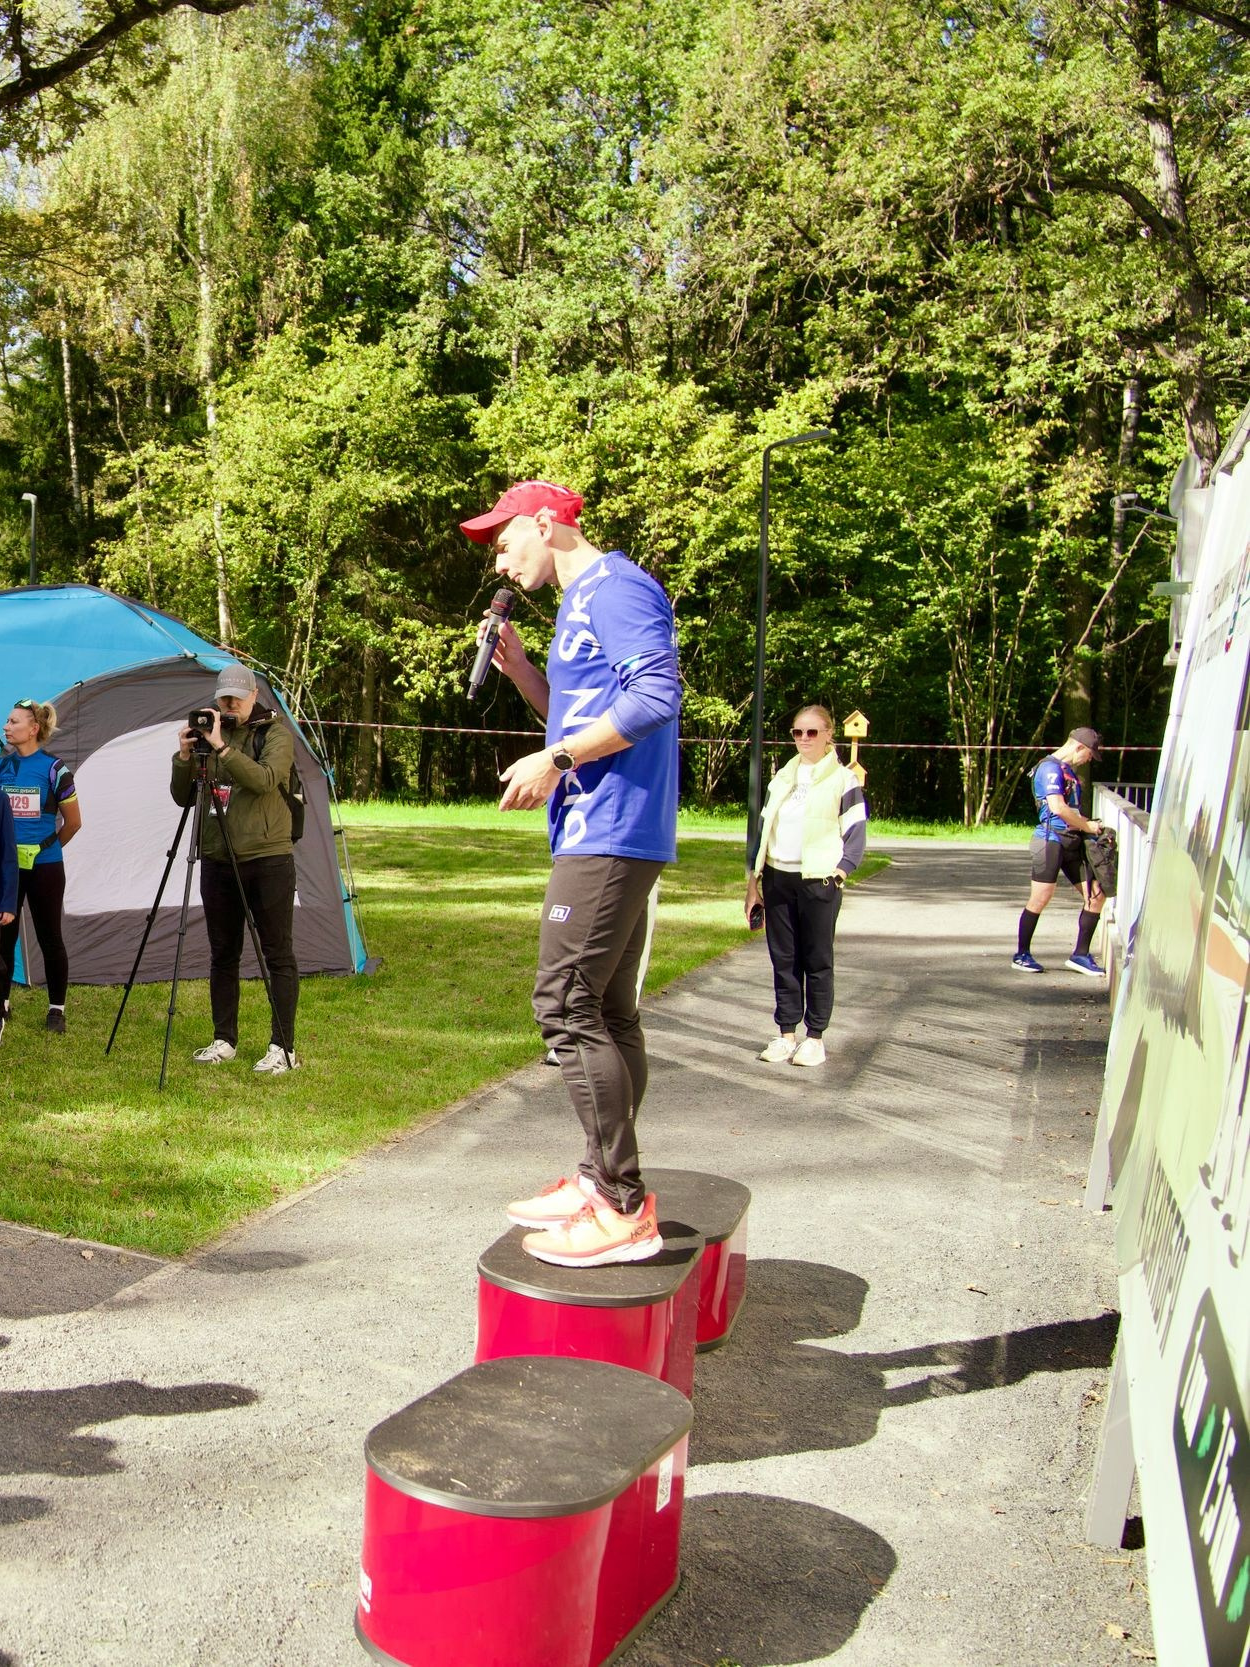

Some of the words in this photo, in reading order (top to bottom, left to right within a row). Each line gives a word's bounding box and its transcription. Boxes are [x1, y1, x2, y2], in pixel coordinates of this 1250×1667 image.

[558, 560, 610, 662] SKY
[10, 796, 29, 809] 129
[630, 1220, 652, 1240] HOKA
